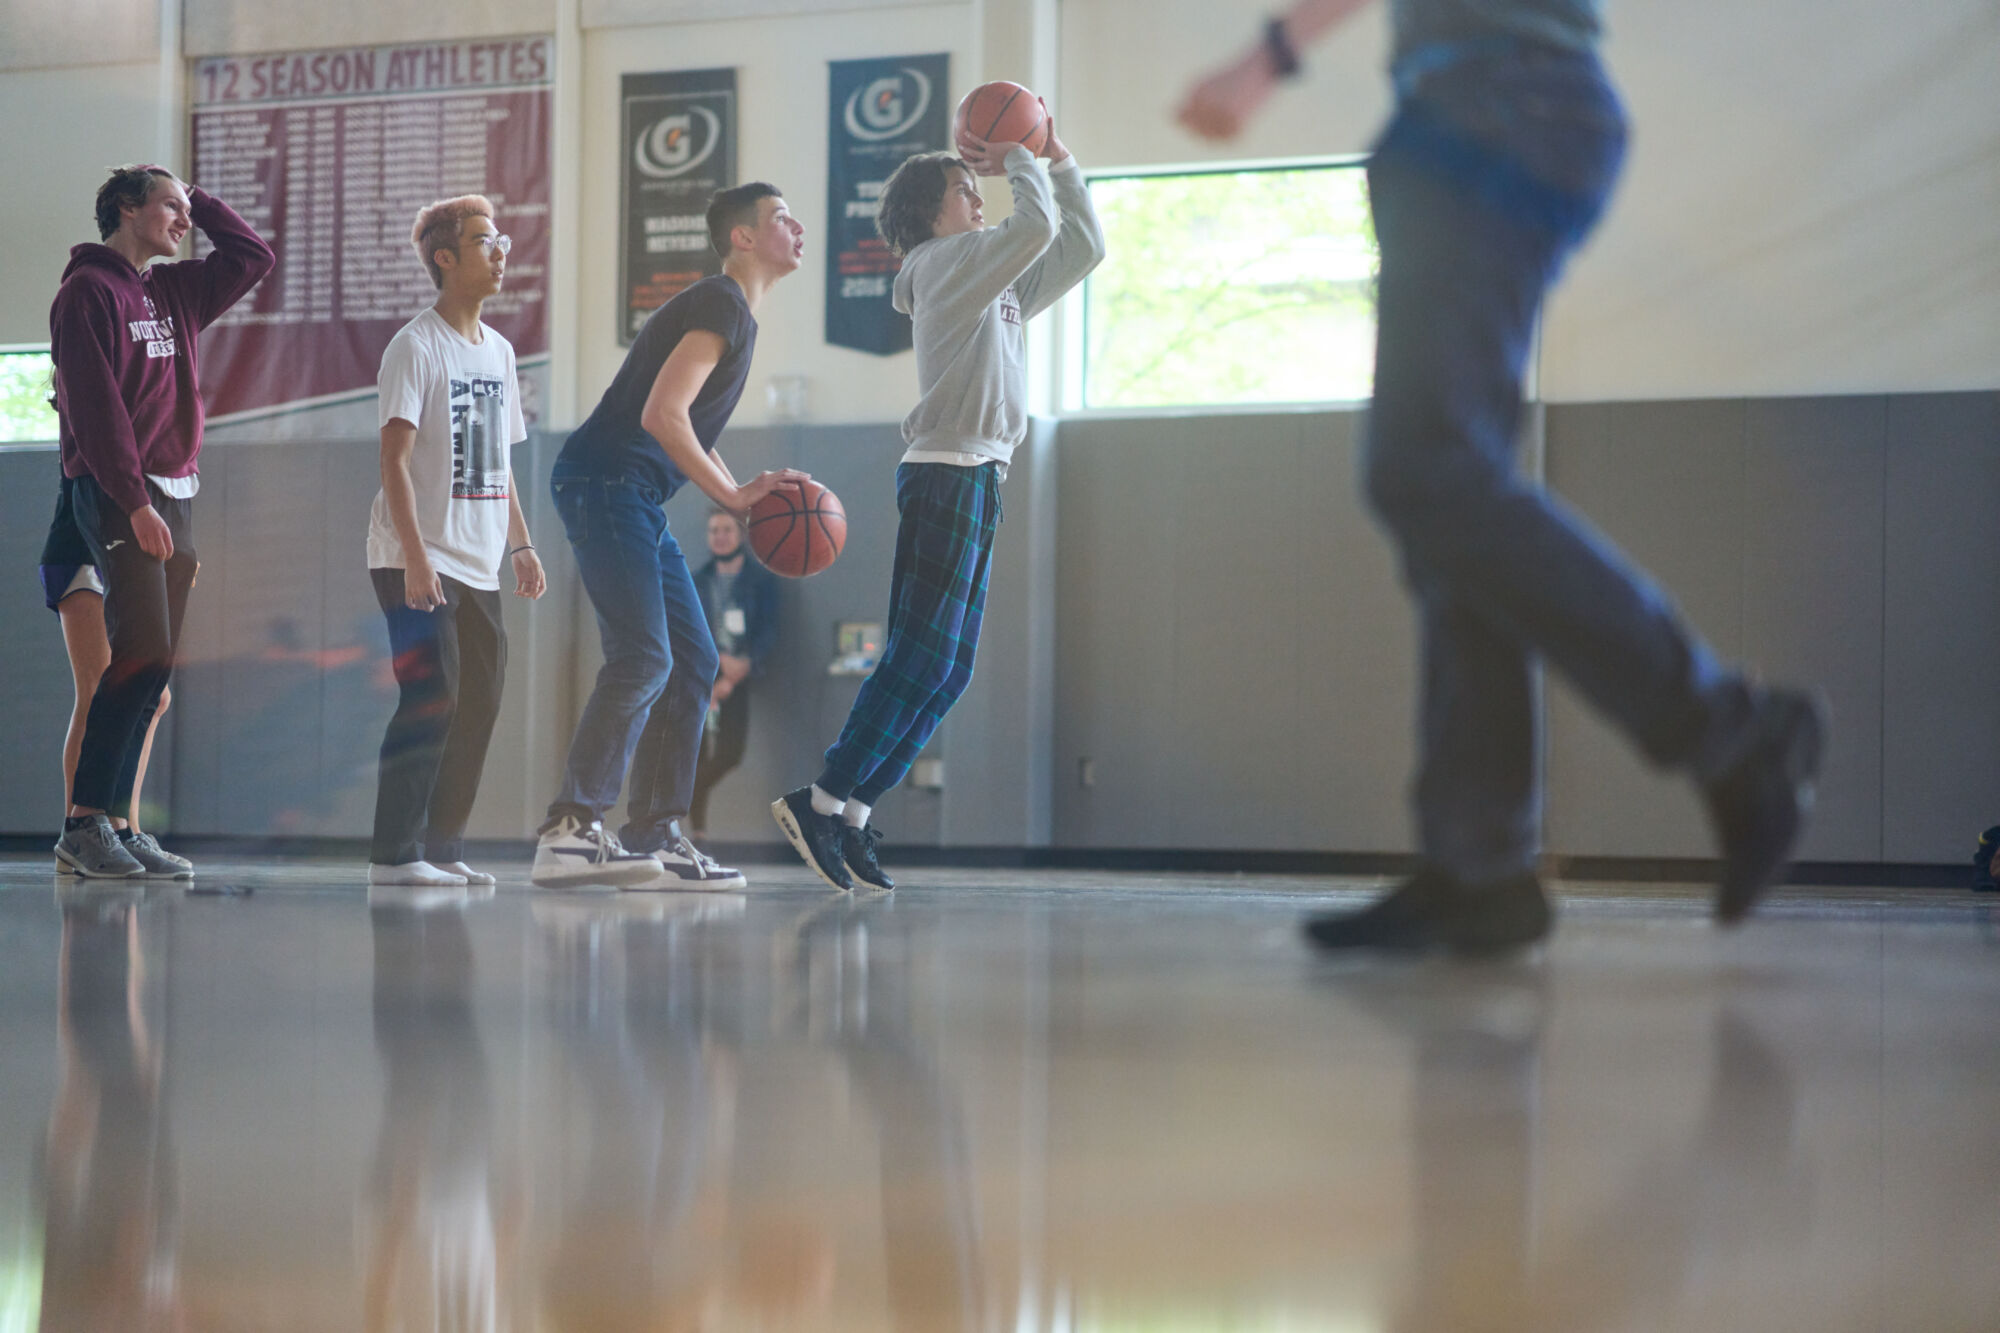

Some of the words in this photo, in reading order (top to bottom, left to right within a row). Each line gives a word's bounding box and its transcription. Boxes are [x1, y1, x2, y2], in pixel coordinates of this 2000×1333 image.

[202, 63, 240, 101] 12
[250, 50, 376, 98] SEASON
[385, 38, 546, 91] ATHLETES
